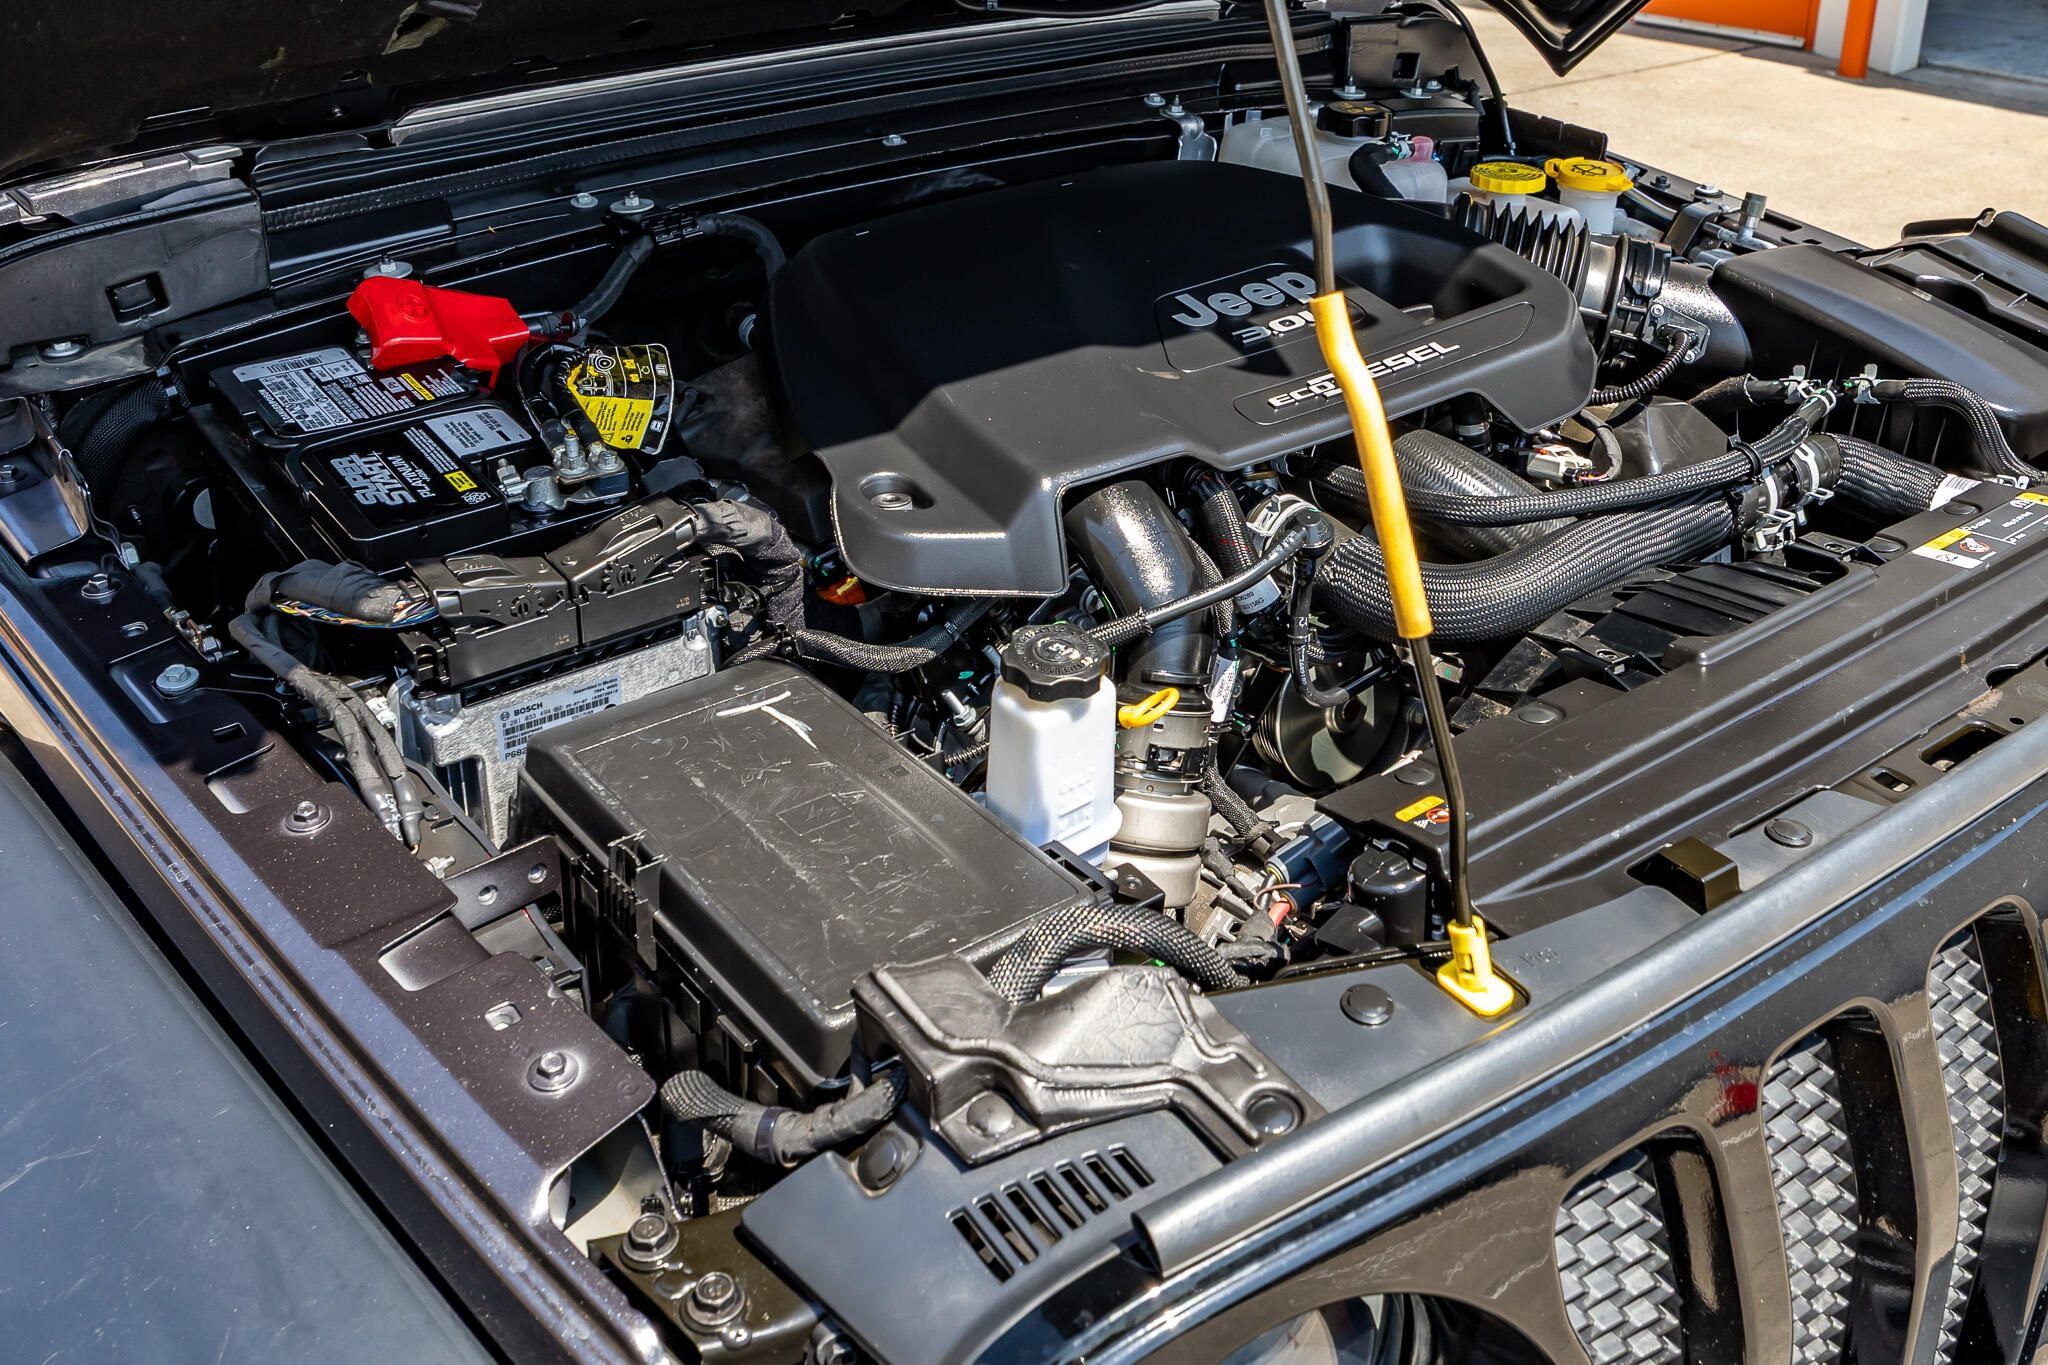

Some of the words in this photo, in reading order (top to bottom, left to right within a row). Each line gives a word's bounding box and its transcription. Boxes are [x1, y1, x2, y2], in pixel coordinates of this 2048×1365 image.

[1171, 271, 1317, 327] Jeep
[1267, 341, 1461, 408] ECODESEL
[330, 453, 378, 505] SUPER
[359, 452, 417, 505] START
[388, 455, 436, 498] PLATINUM
[514, 702, 543, 716] BOSCH
